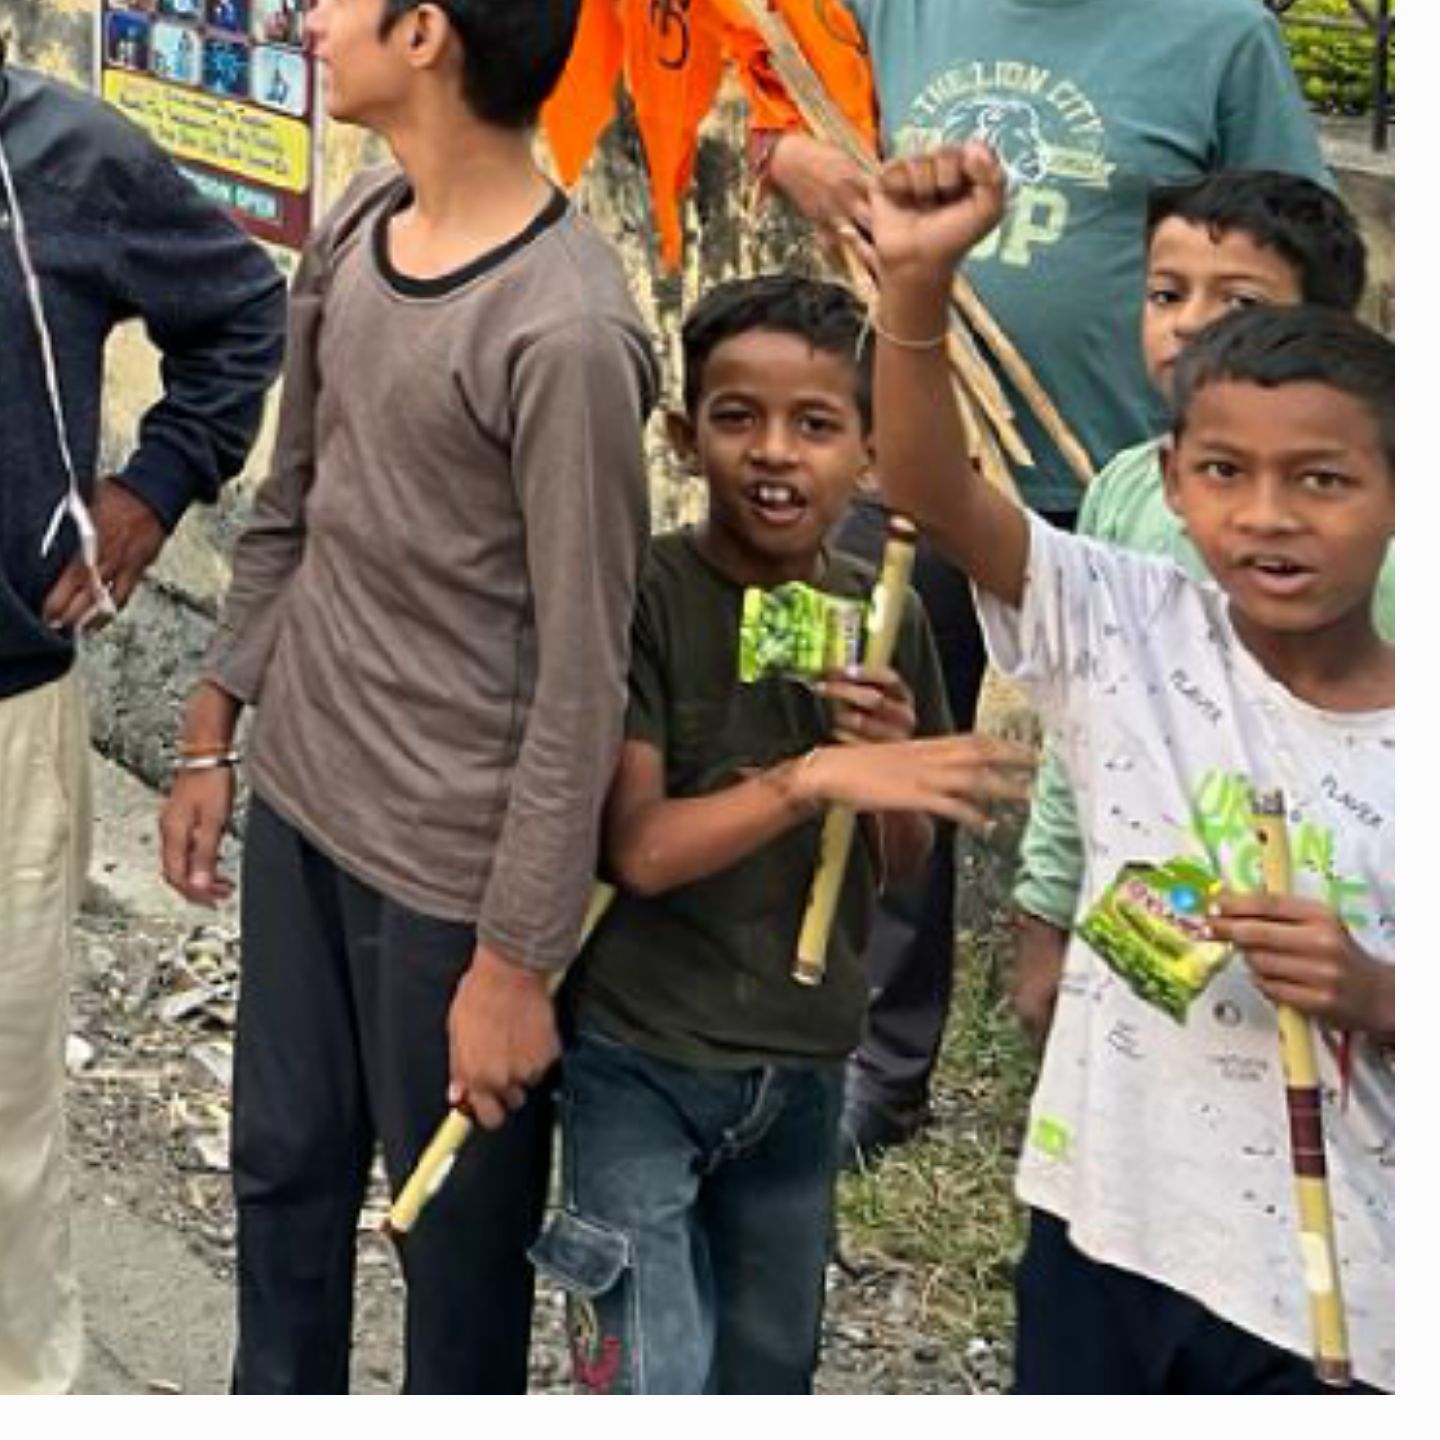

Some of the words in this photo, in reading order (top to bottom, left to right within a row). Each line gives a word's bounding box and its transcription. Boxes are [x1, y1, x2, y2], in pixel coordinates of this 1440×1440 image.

[912, 68, 971, 114] THE
[972, 60, 1051, 95] LION
[1045, 80, 1106, 136] CITY
